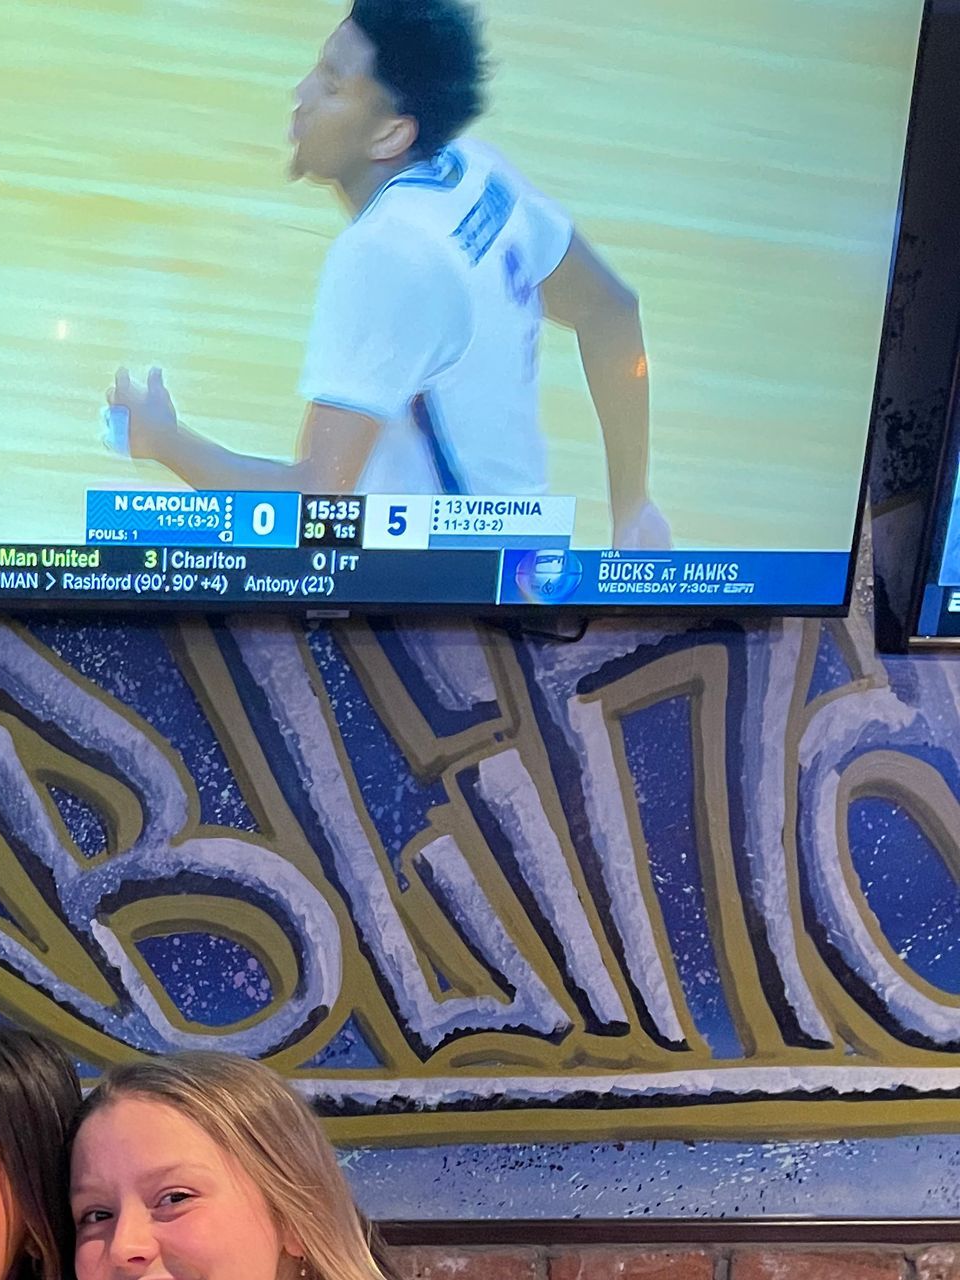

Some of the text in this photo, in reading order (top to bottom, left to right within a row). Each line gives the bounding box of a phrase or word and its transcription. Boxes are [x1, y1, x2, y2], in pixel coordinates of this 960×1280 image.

[114, 495, 220, 512] N CAROLINA
[306, 500, 361, 520] 15:35
[445, 500, 542, 516] 13 VIRGINIA
[157, 515, 220, 529] 11-5 (3-2)
[252, 502, 275, 536] 0
[387, 504, 408, 536] 5
[443, 518, 503, 532] 11-3 (3-2)
[88, 529, 138, 540] FOULS: 1
[304, 522, 356, 539] 30 1st
[0, 549, 158, 569] Man United 3
[171, 552, 359, 571] Charlton 0 FT
[600, 550, 621, 558] NBA
[598, 563, 740, 581] BUCKS AT HAWKS
[0, 572, 335, 596] MAN Rashford (90', 90' +4) Antony (21')
[597, 582, 677, 593] WEDNESDAY
[723, 583, 755, 594] ESPN
